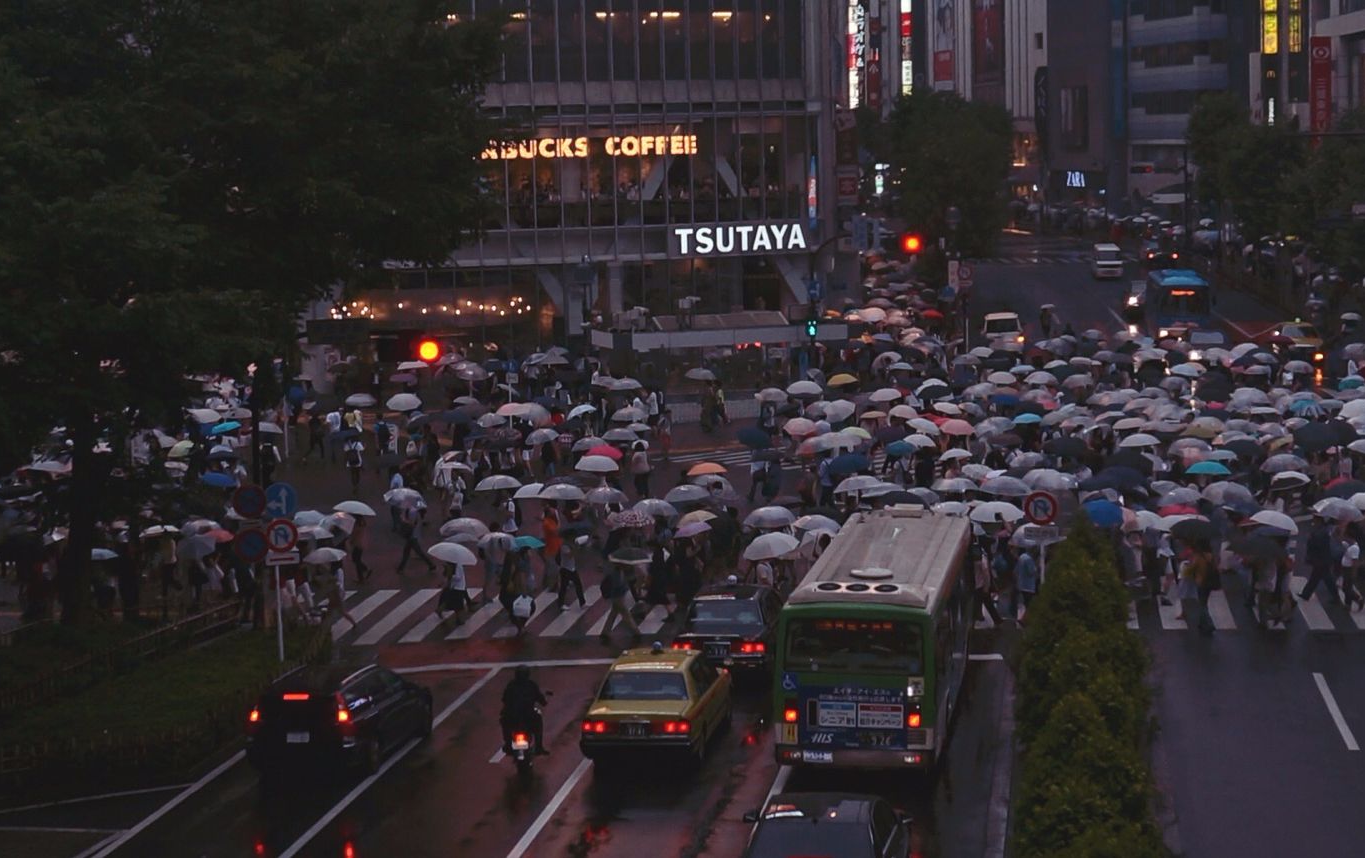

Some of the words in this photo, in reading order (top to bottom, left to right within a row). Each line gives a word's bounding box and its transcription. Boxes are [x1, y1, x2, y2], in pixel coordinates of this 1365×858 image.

[481, 137, 589, 160] RBUCKS
[605, 135, 697, 156] COFFEE
[1066, 171, 1085, 187] ZARA
[675, 224, 806, 254] TSUTAYA
